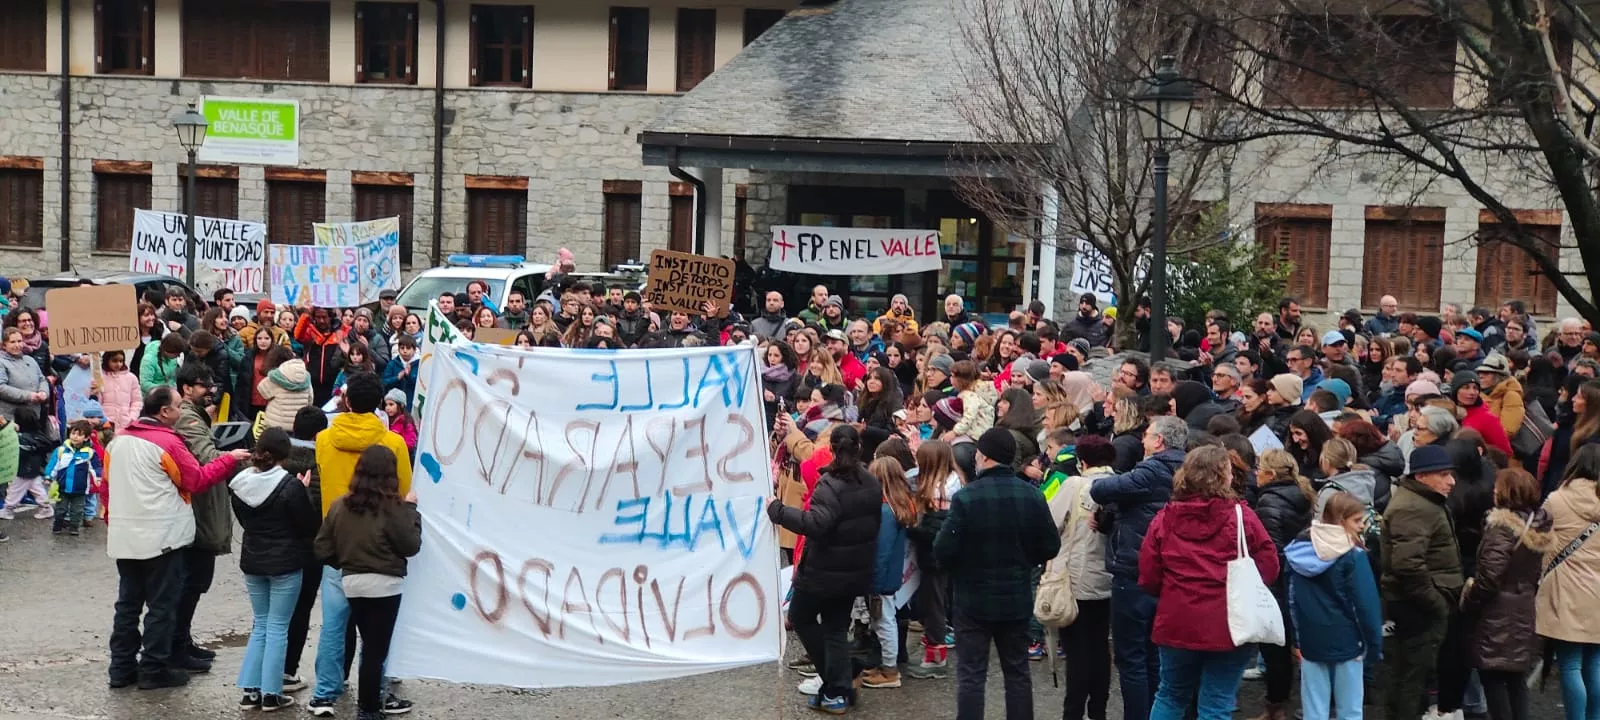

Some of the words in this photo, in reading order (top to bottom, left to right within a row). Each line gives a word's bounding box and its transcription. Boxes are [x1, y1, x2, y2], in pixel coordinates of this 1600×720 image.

[218, 109, 258, 121] VALLE
[262, 111, 280, 122] DE
[214, 121, 284, 138] BENASQUE
[163, 214, 187, 234] UN
[203, 219, 250, 241] VALLE
[137, 232, 166, 255] UNA
[880, 233, 937, 257] VALLE
[655, 255, 729, 278] INSTITUTO
[167, 264, 262, 292] ITUTO
[653, 279, 726, 299] INSTITUTO
[284, 284, 349, 306] VALLE
[646, 292, 667, 305] DEL
[670, 296, 708, 312] VALLE
[56, 328, 76, 348] UN
[80, 326, 139, 345] INSTITUTO
